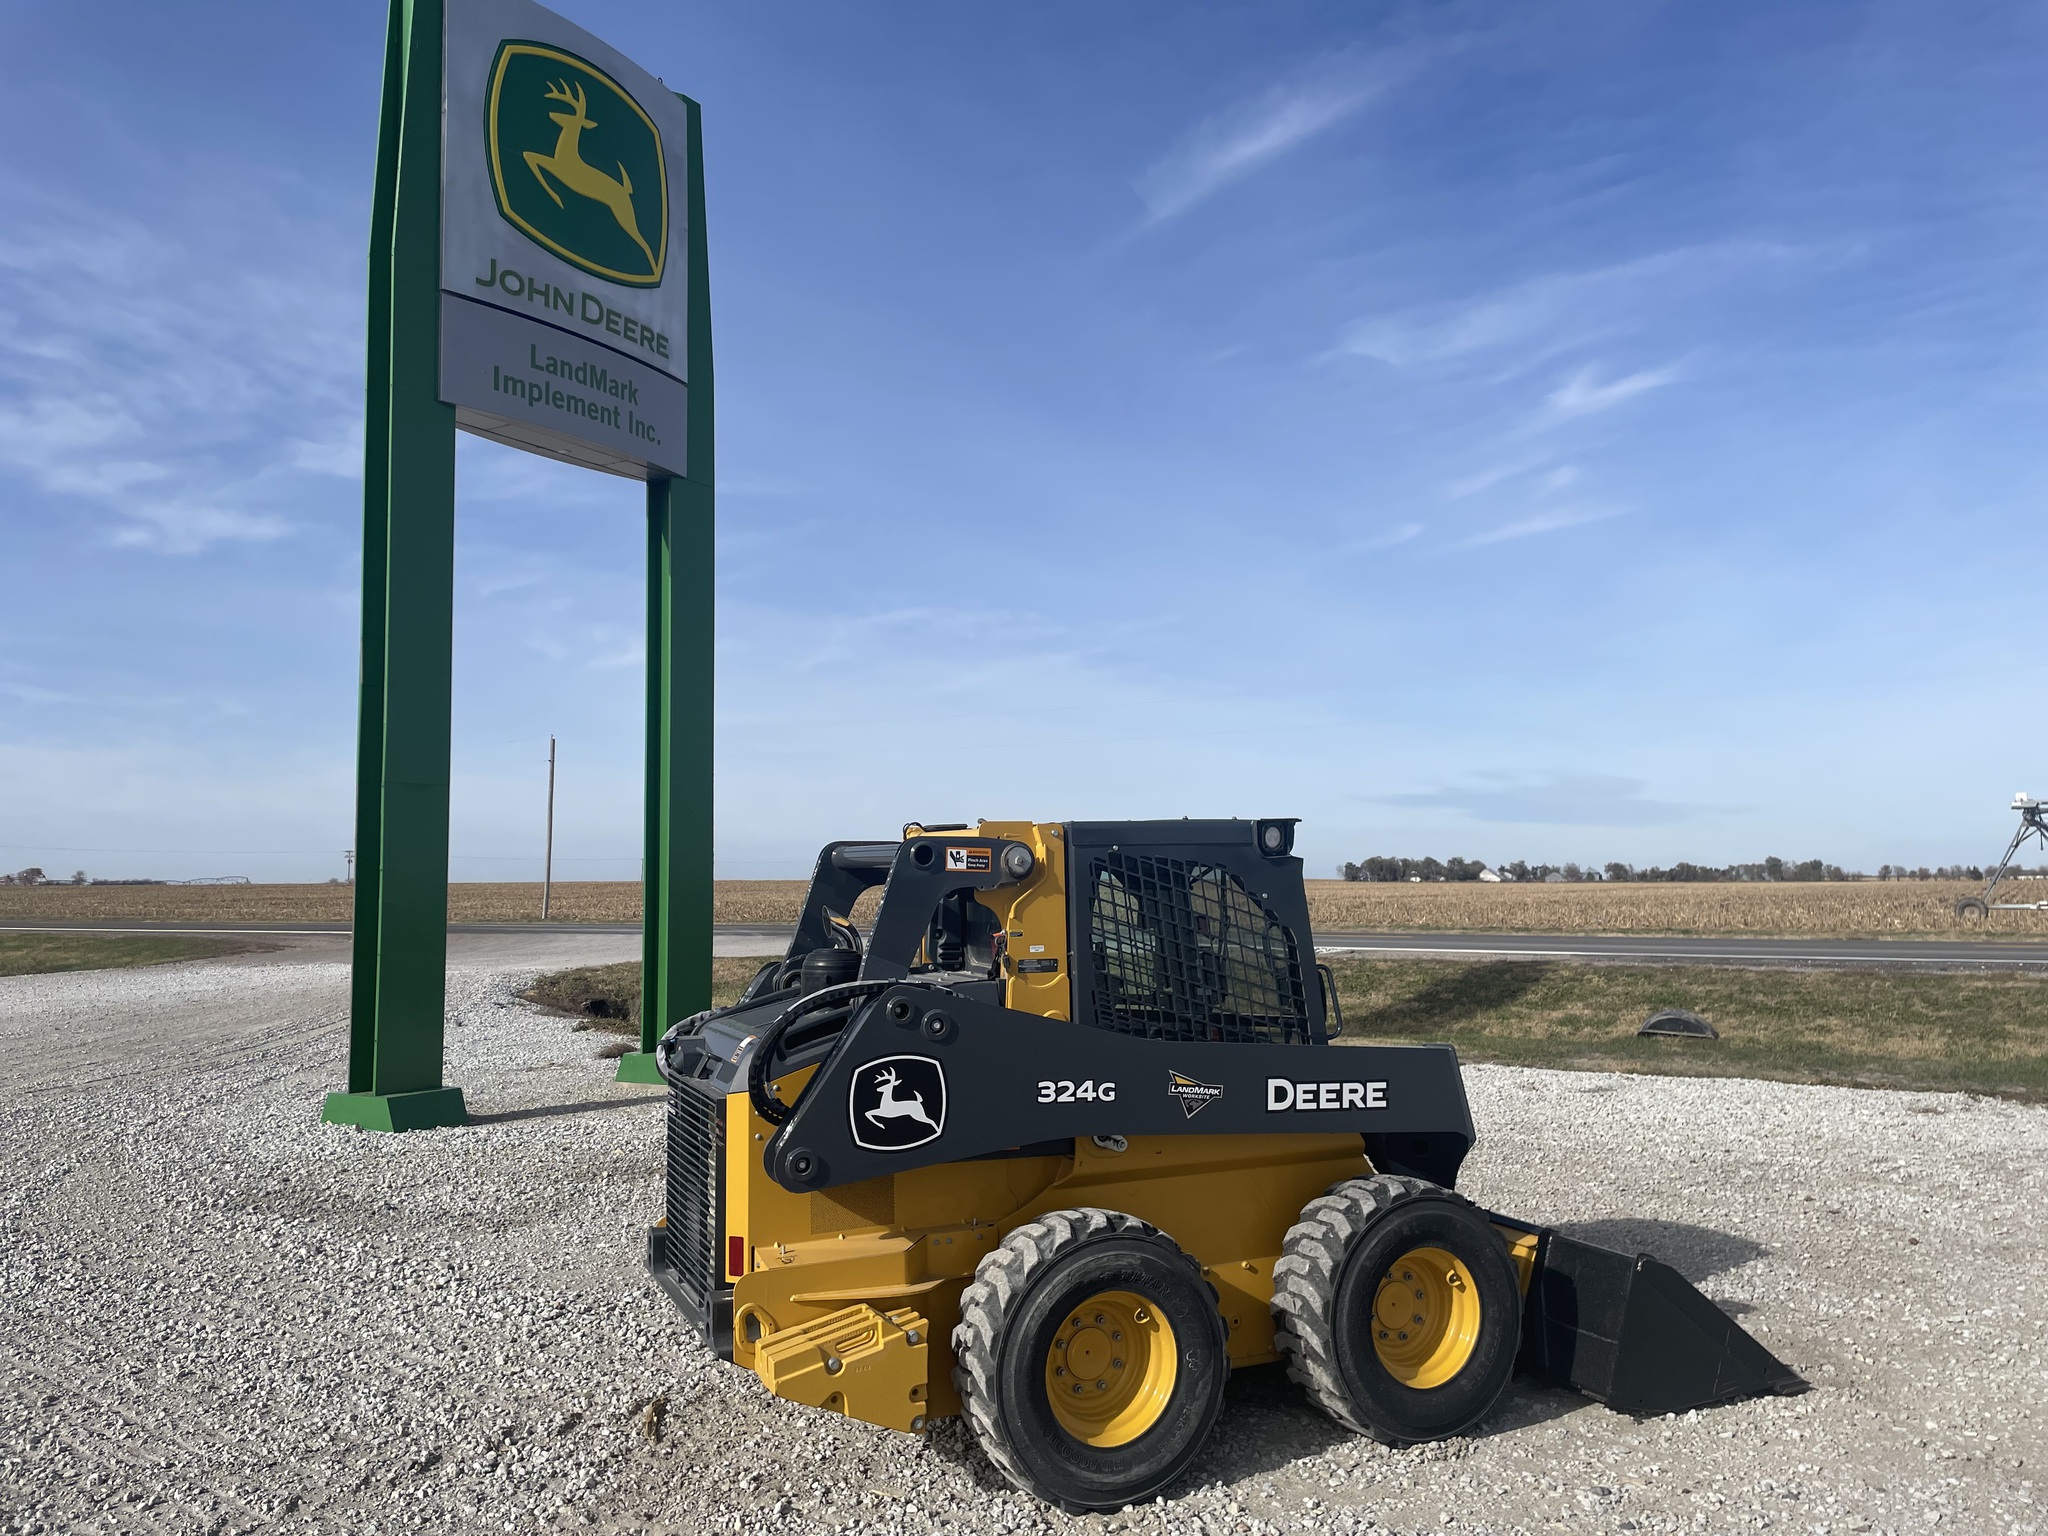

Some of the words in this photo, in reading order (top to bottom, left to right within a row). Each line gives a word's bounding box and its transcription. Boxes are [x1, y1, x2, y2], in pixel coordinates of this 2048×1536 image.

[475, 258, 574, 317] JOHN
[581, 292, 669, 360] DEERE
[530, 343, 639, 406] LandMark
[493, 365, 620, 430] Implement
[628, 411, 661, 446] Inc.
[1037, 1080, 1116, 1104] 324G
[1171, 1085, 1221, 1096] LANDMARK
[1267, 1078, 1387, 1111] DEERE
